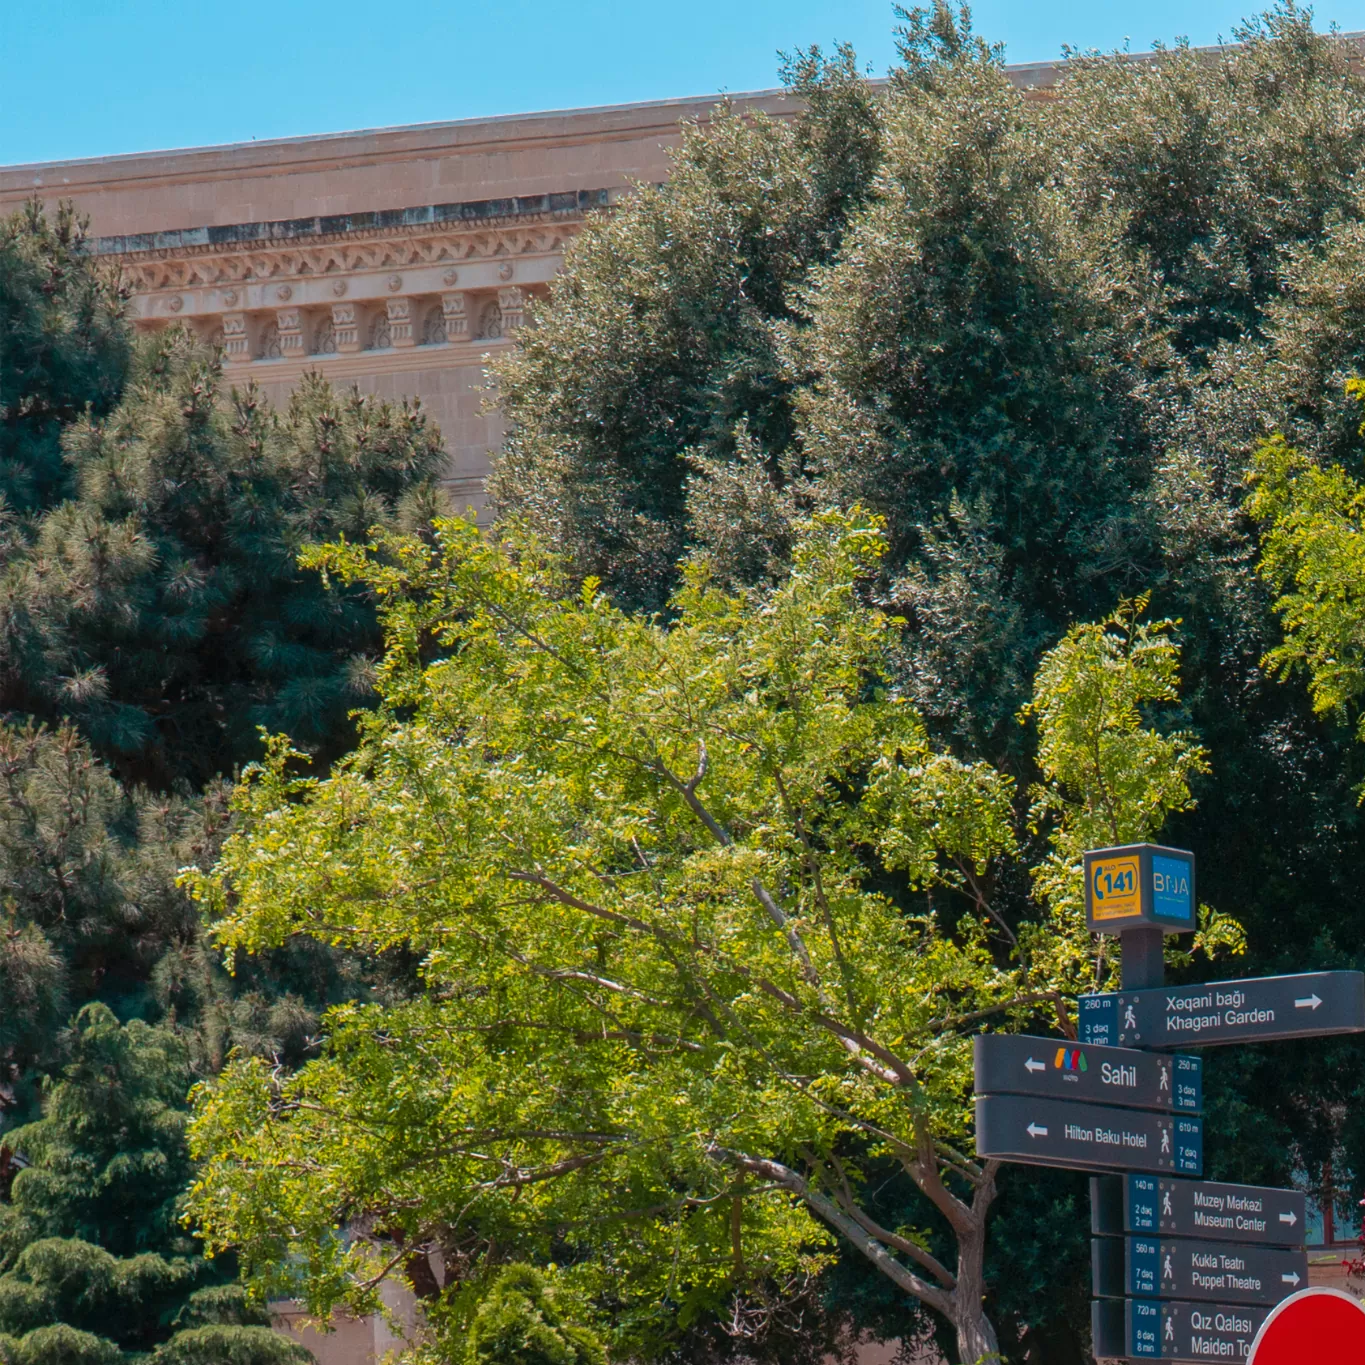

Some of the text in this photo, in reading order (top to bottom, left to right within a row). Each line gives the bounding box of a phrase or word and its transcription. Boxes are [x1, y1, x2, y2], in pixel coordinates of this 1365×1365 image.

[1103, 870, 1133, 893] 141
[1102, 999, 1111, 1008] m
[1166, 990, 1245, 1013] Xəqani bağı
[1166, 1008, 1275, 1032] Khagani Garden
[1085, 1024, 1091, 1034] 3
[1101, 1062, 1137, 1087] Sahil
[1178, 1084, 1183, 1093] 3
[1178, 1096, 1183, 1106] 3
[1064, 1124, 1147, 1148] Hilton Baku Hotel
[1179, 1146, 1184, 1155] 7
[1180, 1159, 1184, 1168] 7
[1135, 1205, 1140, 1214] 2
[1193, 1191, 1263, 1212] Muzey Mərkəzi
[1135, 1217, 1140, 1226] 2
[1194, 1211, 1267, 1232] Museum Center
[1191, 1253, 1218, 1269] Kukla
[1136, 1268, 1140, 1277] 7
[1136, 1280, 1141, 1289] 7
[1192, 1271, 1261, 1291] Puppet Theatre
[1190, 1311, 1252, 1333] Qız Qalası
[1191, 1336, 1251, 1356] Maiden To
